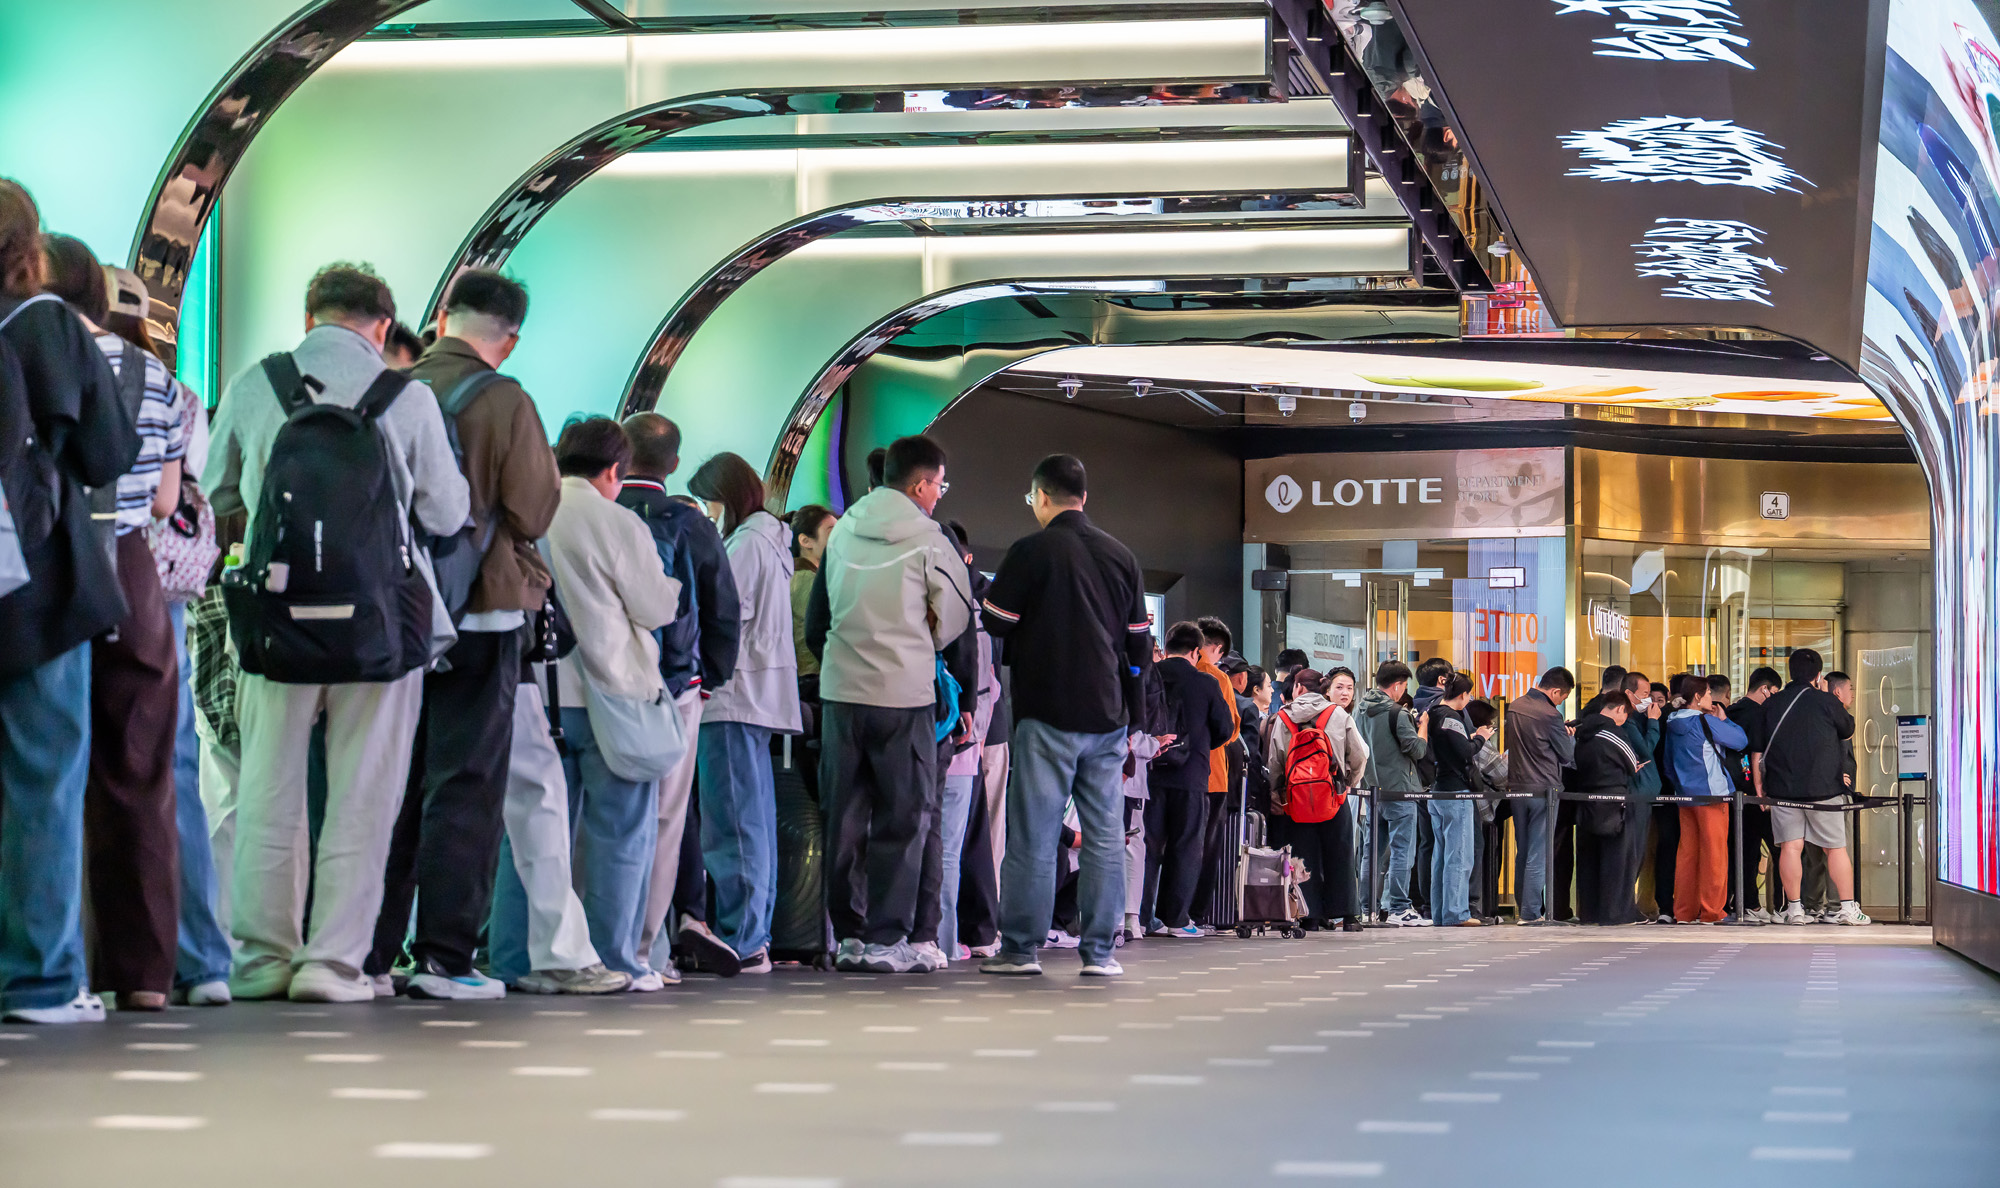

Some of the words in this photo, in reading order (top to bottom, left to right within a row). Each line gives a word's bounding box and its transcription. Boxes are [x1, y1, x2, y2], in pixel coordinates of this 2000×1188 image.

[1312, 477, 1442, 506] LOTTE
[1457, 475, 1542, 489] DEPARTMENT
[1457, 490, 1499, 502] STORE
[1771, 496, 1779, 508] 4
[1766, 508, 1783, 516] GATE
